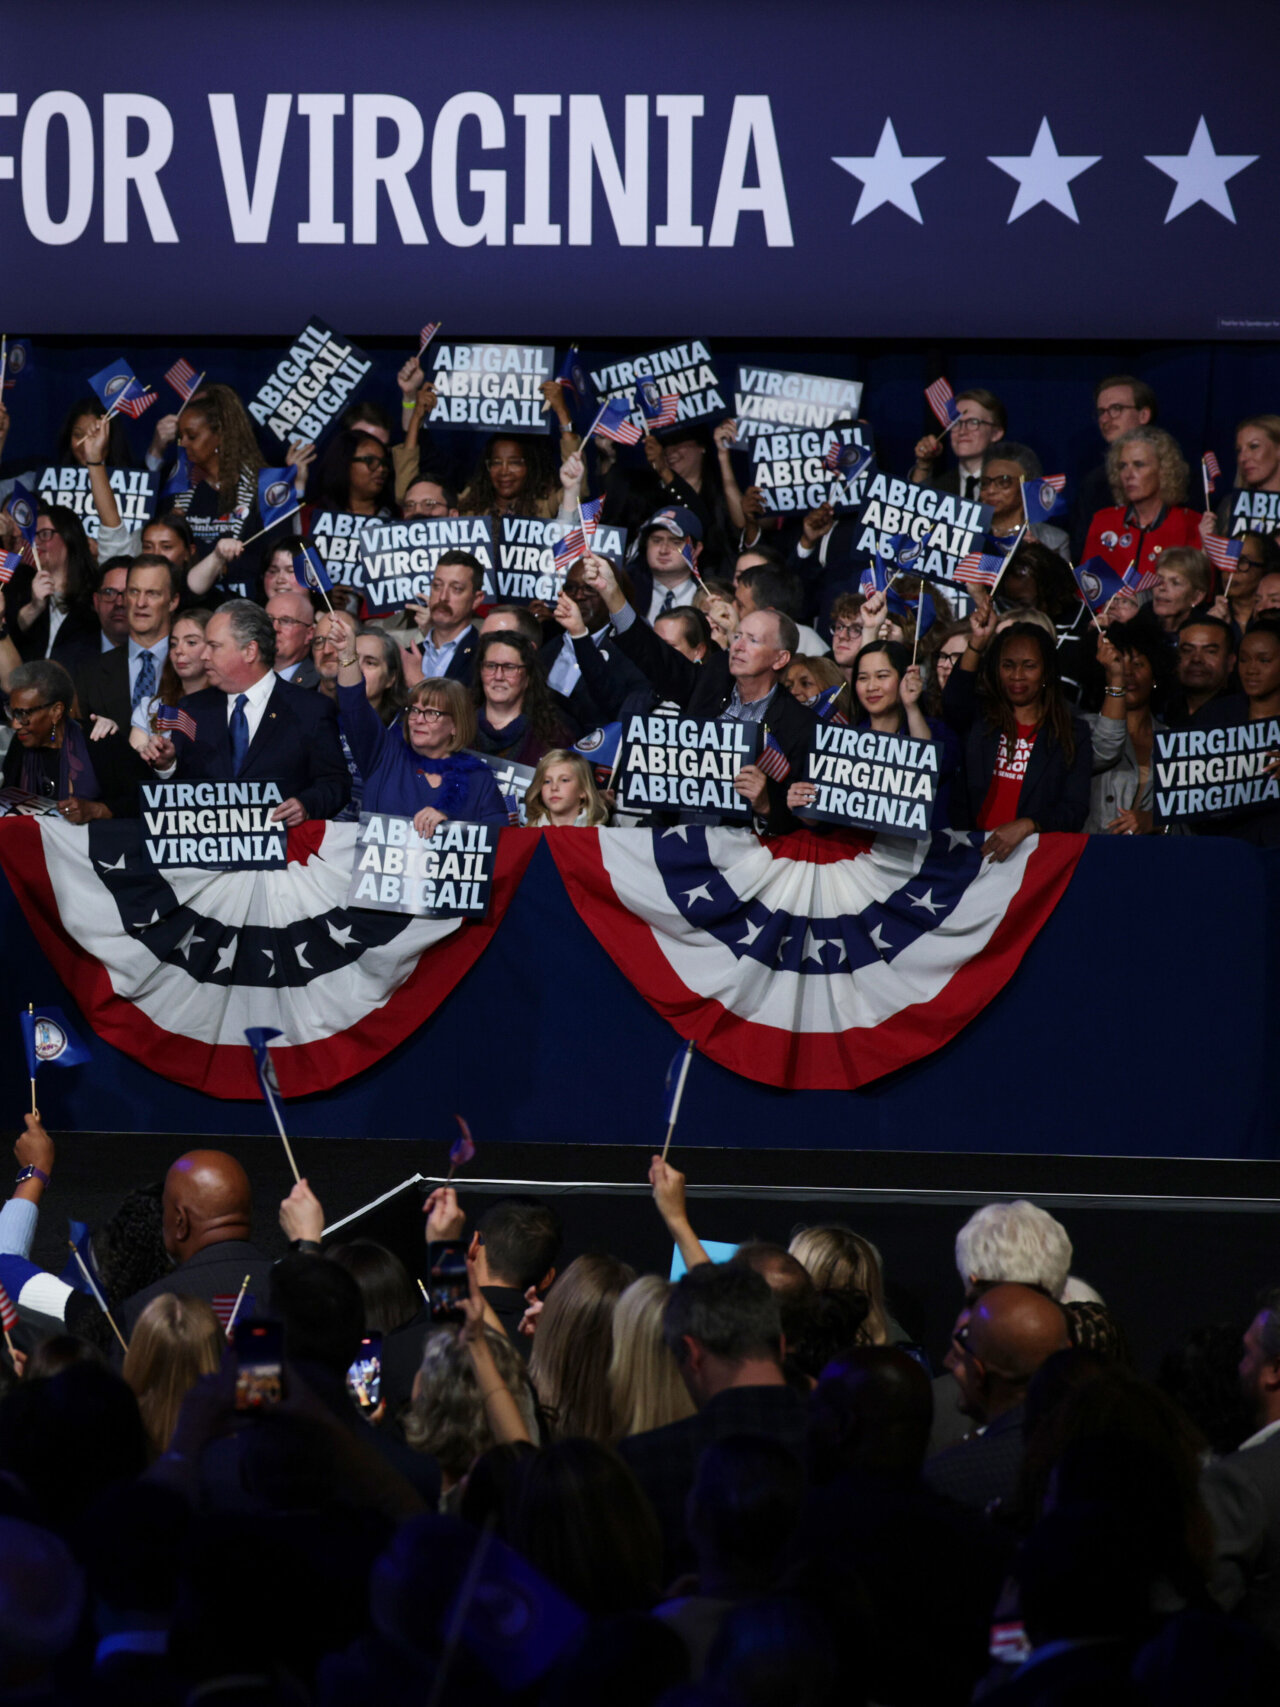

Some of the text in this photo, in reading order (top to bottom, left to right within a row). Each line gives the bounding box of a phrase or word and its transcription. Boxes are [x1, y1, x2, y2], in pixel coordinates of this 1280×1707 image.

[208, 91, 794, 248] VIRGINIA
[248, 325, 332, 426] ABIGAIL
[433, 346, 549, 374] ABIGAIL
[590, 340, 711, 392] VIRGINIA
[267, 340, 352, 442] ABIGAIL
[288, 355, 372, 450] ABIGAIL
[432, 371, 544, 400] ABIGAIL
[739, 368, 857, 408] VIRGINIA
[429, 397, 546, 426] ABIGAIL
[38, 467, 153, 496] ABIAIL
[867, 473, 983, 533] ABIGAIL
[1233, 491, 1280, 519] ABI
[361, 519, 491, 552] VIRGINIA
[503, 518, 622, 555] VIRGIA
[363, 545, 492, 579] VIRGIA
[497, 572, 567, 600] VIRGI
[626, 715, 750, 752] ABIGAIL
[816, 724, 938, 772] VIRGINIA
[1156, 720, 1280, 758] VIRGINIA
[142, 782, 283, 808] VIRGINIA
[627, 773, 747, 811] ABIGAIL
[809, 753, 933, 802] VIRGINIA
[1156, 778, 1280, 816] VIRGINIA
[144, 807, 284, 835] VIRGINIA
[362, 816, 492, 853] ABIGAIL
[145, 835, 285, 863] VIRGINIA
[358, 845, 488, 881] ABIGAIL
[354, 873, 484, 909] ABIGAIL
